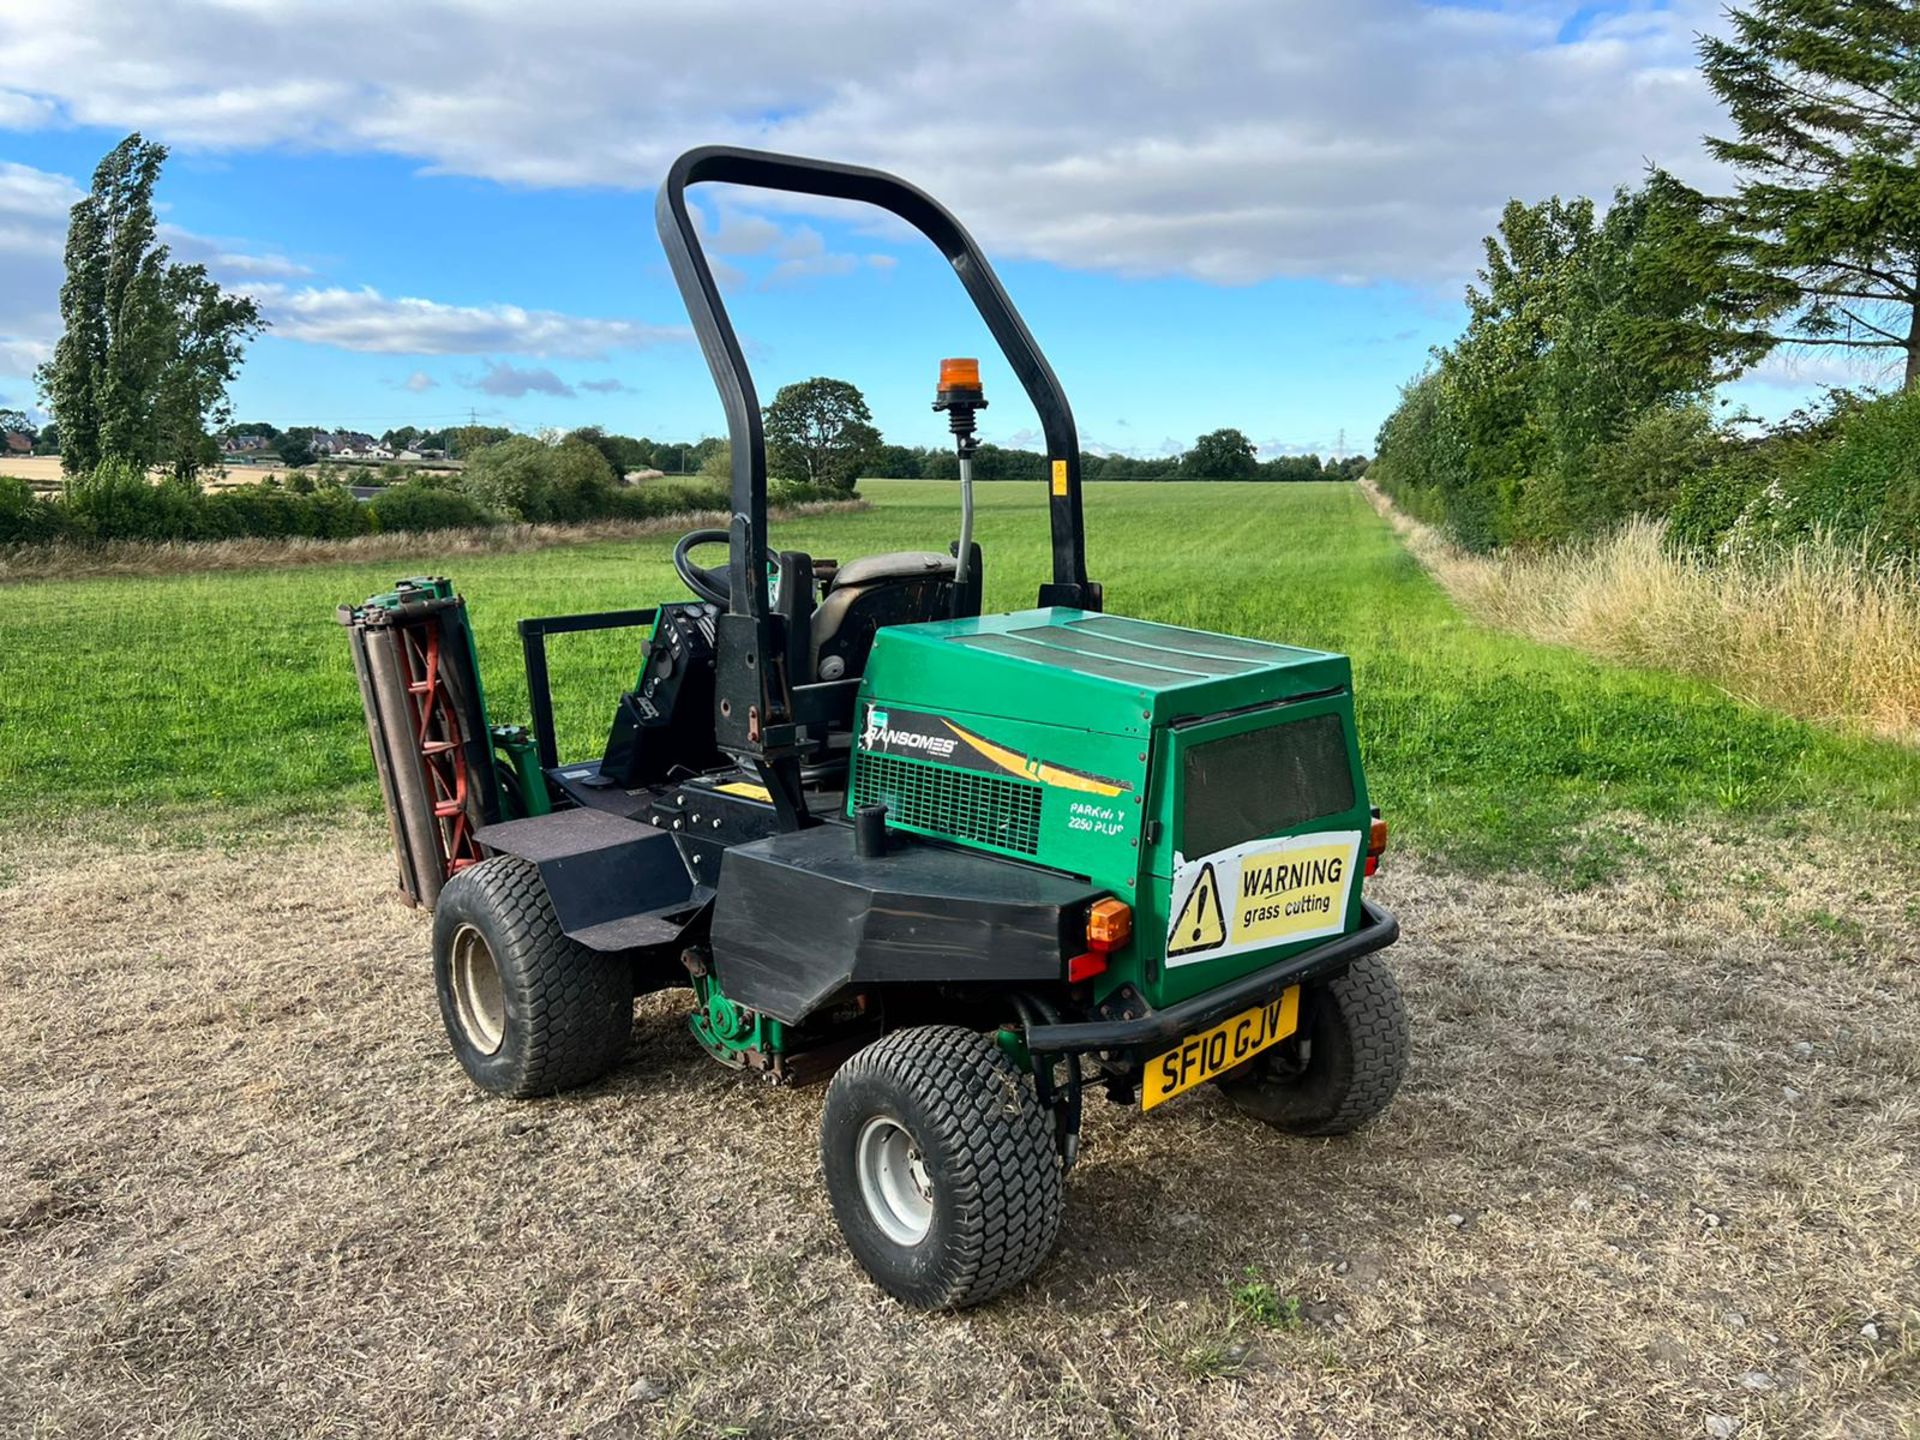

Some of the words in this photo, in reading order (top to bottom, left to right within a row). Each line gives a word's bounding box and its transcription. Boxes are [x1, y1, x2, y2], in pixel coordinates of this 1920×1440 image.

[1068, 816, 1093, 832] 2250
[1243, 858, 1342, 897] WARNING
[1243, 905, 1280, 928] grass
[1285, 894, 1330, 917] cutting
[1161, 1030, 1227, 1094] SF10
[1234, 1000, 1282, 1058] GJV
